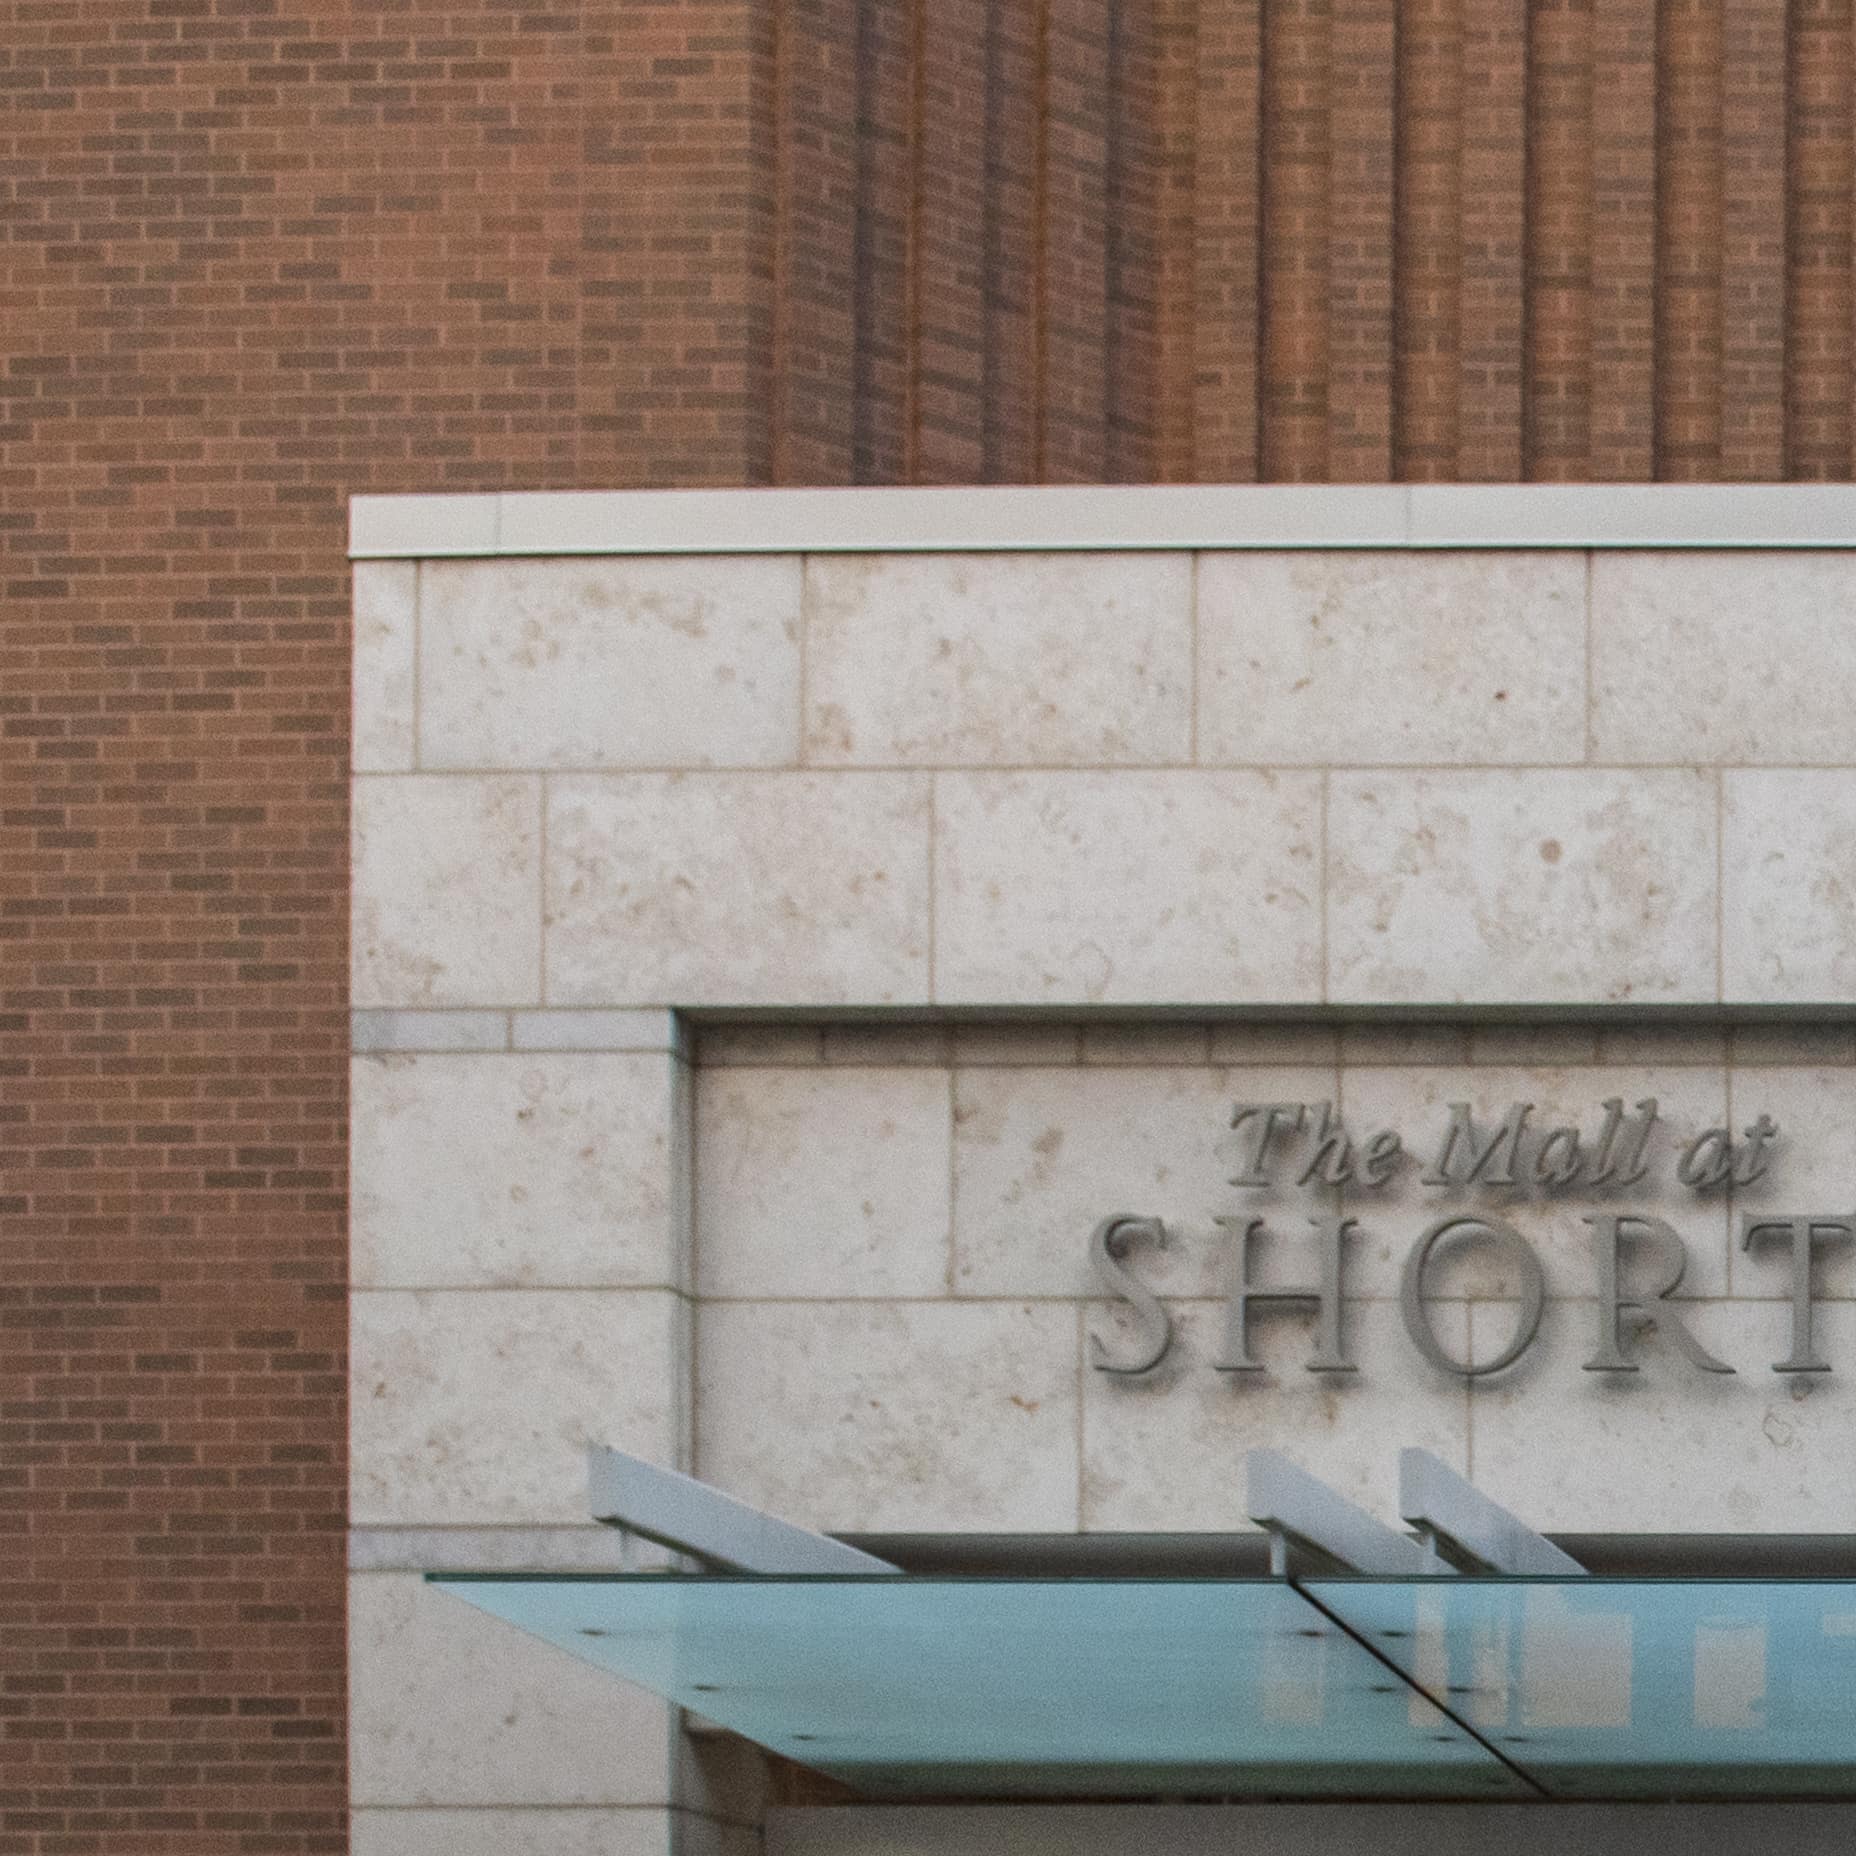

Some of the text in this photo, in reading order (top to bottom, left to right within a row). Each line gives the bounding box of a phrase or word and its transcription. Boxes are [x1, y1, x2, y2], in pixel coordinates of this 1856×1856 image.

[1228, 1097, 1780, 1189] The Mall at
